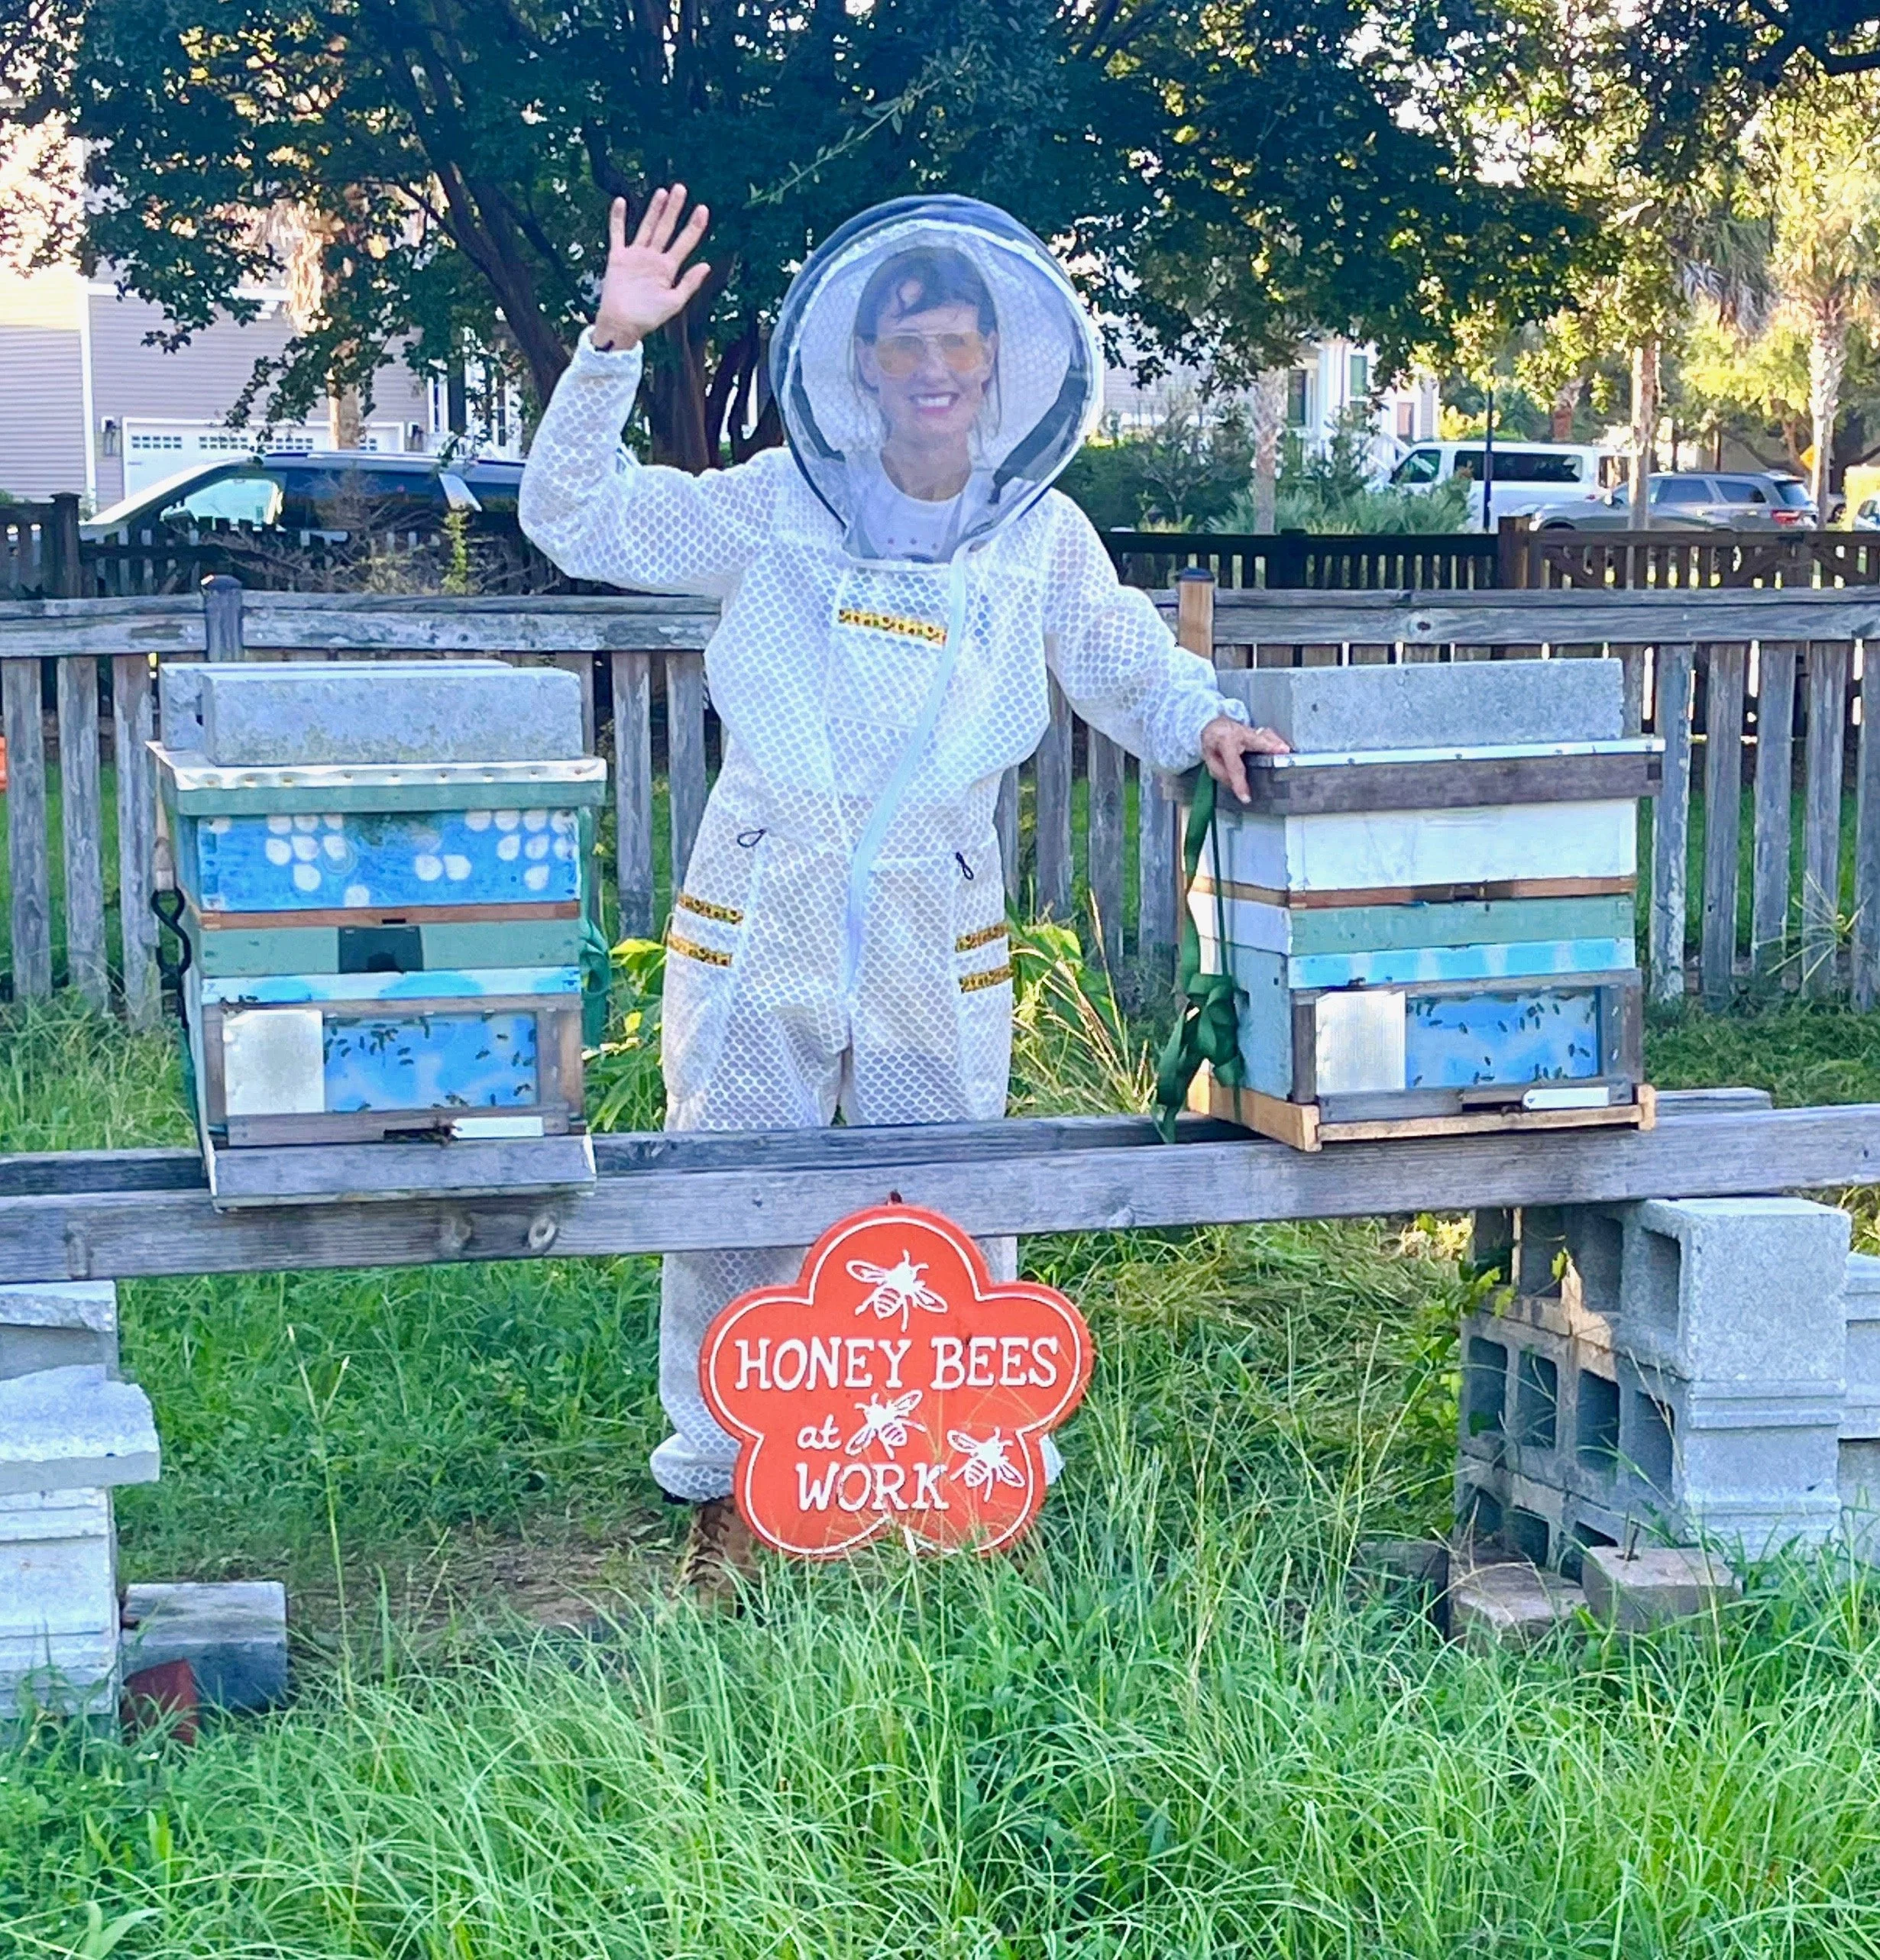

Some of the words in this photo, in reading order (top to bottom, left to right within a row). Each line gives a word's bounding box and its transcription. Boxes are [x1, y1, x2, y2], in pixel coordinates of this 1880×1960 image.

[734, 1336, 912, 1391] HONEY
[930, 1336, 1059, 1390] BEES
[797, 1414, 842, 1451] at
[795, 1462, 950, 1512] WORK
